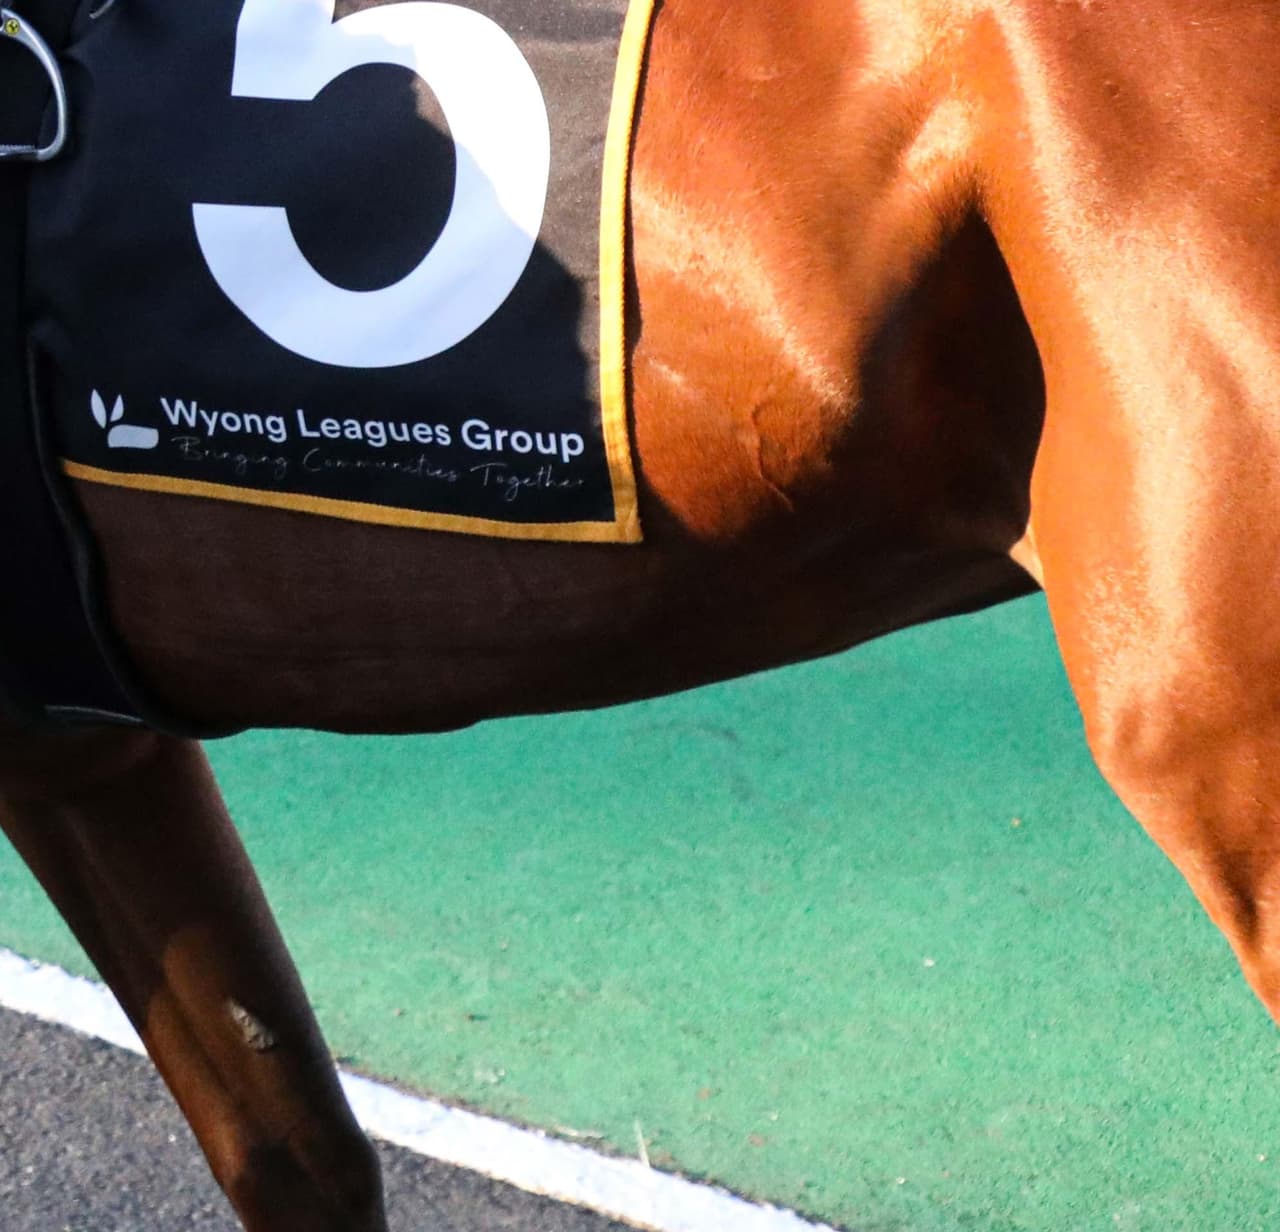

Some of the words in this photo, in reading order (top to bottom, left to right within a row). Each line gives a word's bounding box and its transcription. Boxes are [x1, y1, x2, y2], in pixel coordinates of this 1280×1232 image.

[160, 397, 287, 443] Wyong
[297, 409, 452, 448] Leagues
[461, 419, 585, 463] Group
[470, 462, 585, 502] Together
